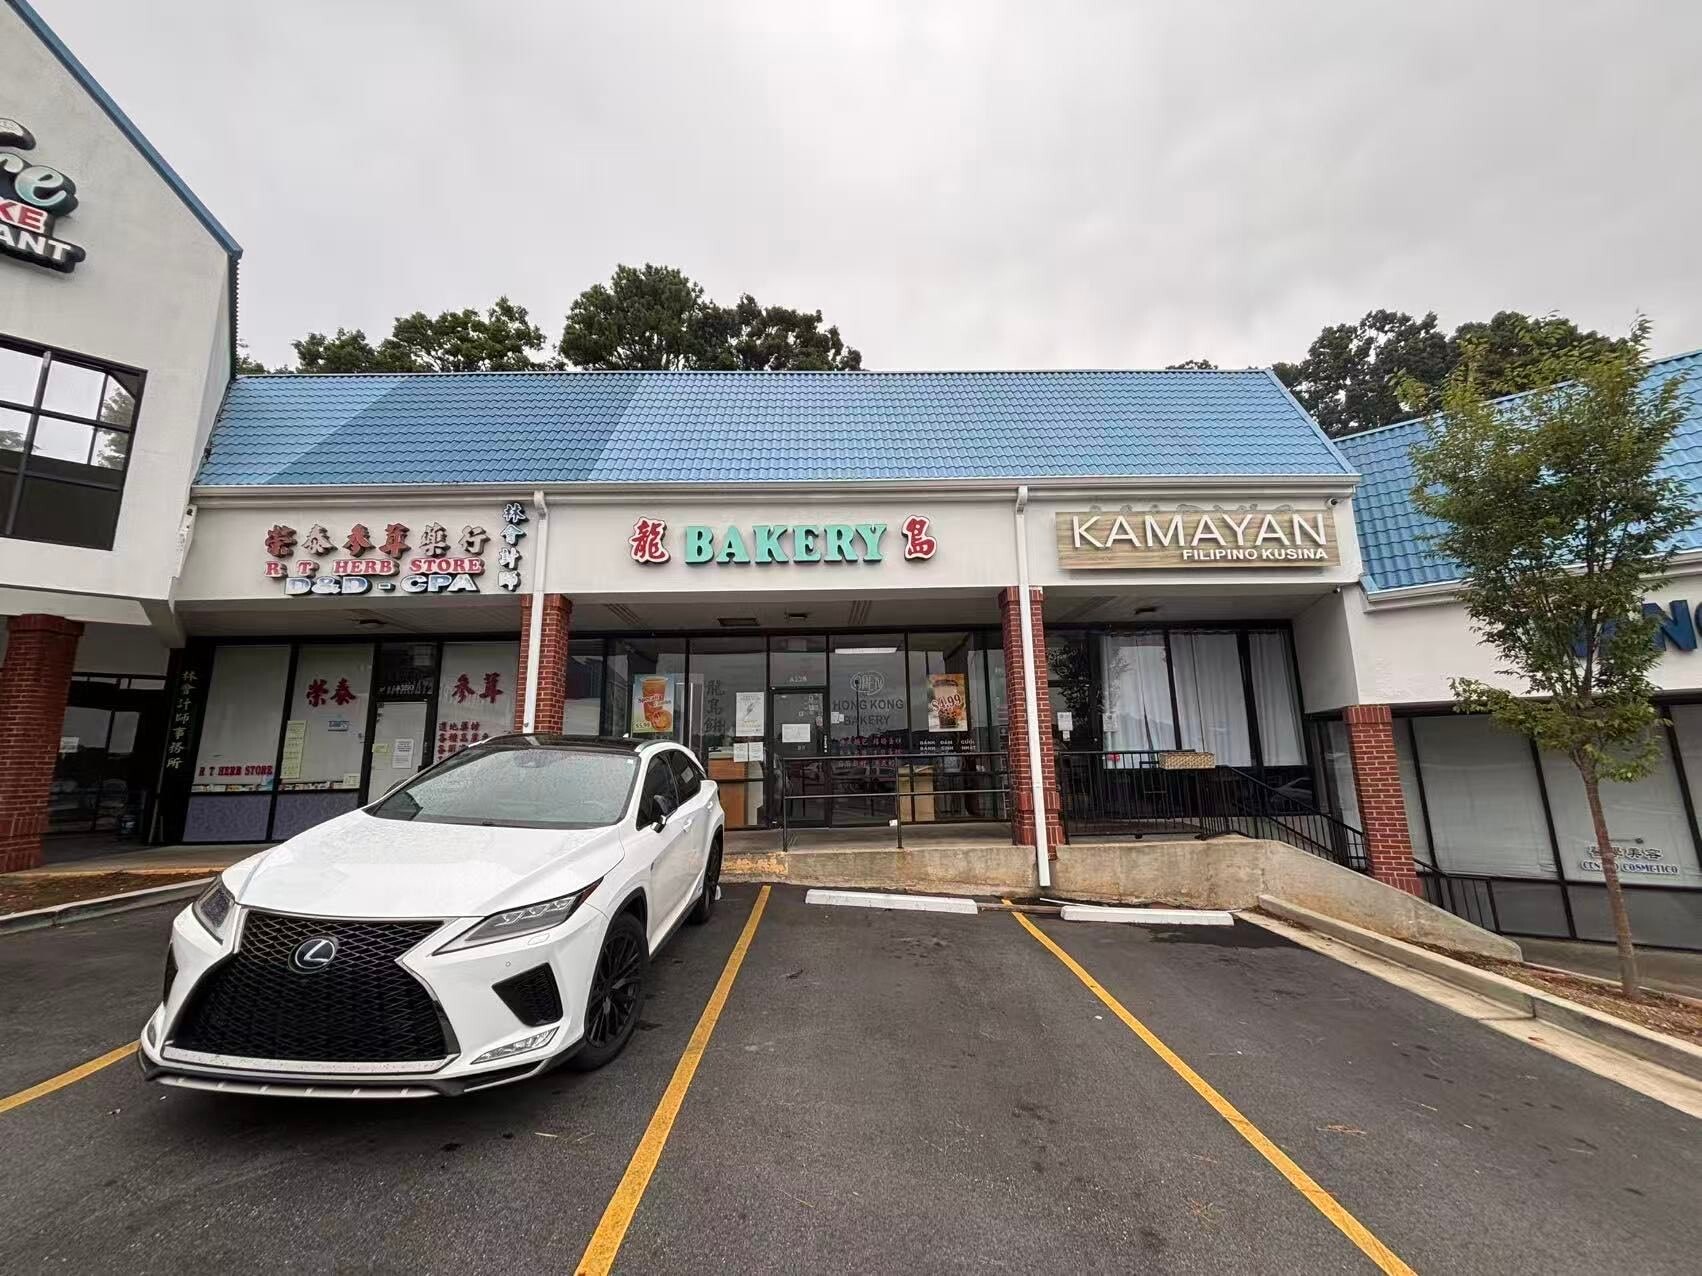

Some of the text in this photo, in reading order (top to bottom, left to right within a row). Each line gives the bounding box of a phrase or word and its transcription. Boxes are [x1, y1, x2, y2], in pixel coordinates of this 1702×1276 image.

[629, 516, 669, 563] 龍
[685, 524, 887, 563] BAKERY
[1072, 513, 1326, 548] KAMAYAN
[1183, 548, 1328, 560] FILIPINO KUSINA
[265, 557, 483, 577] R T HERB STORE
[286, 576, 370, 595] D&D
[401, 574, 480, 592] CPA
[833, 698, 904, 710] HONG KONG
[931, 693, 961, 712] $4.99
[165, 670, 198, 769] 林會計師事務所
[844, 715, 890, 726] BAKERY
[199, 765, 273, 777] R T HERB STORE
